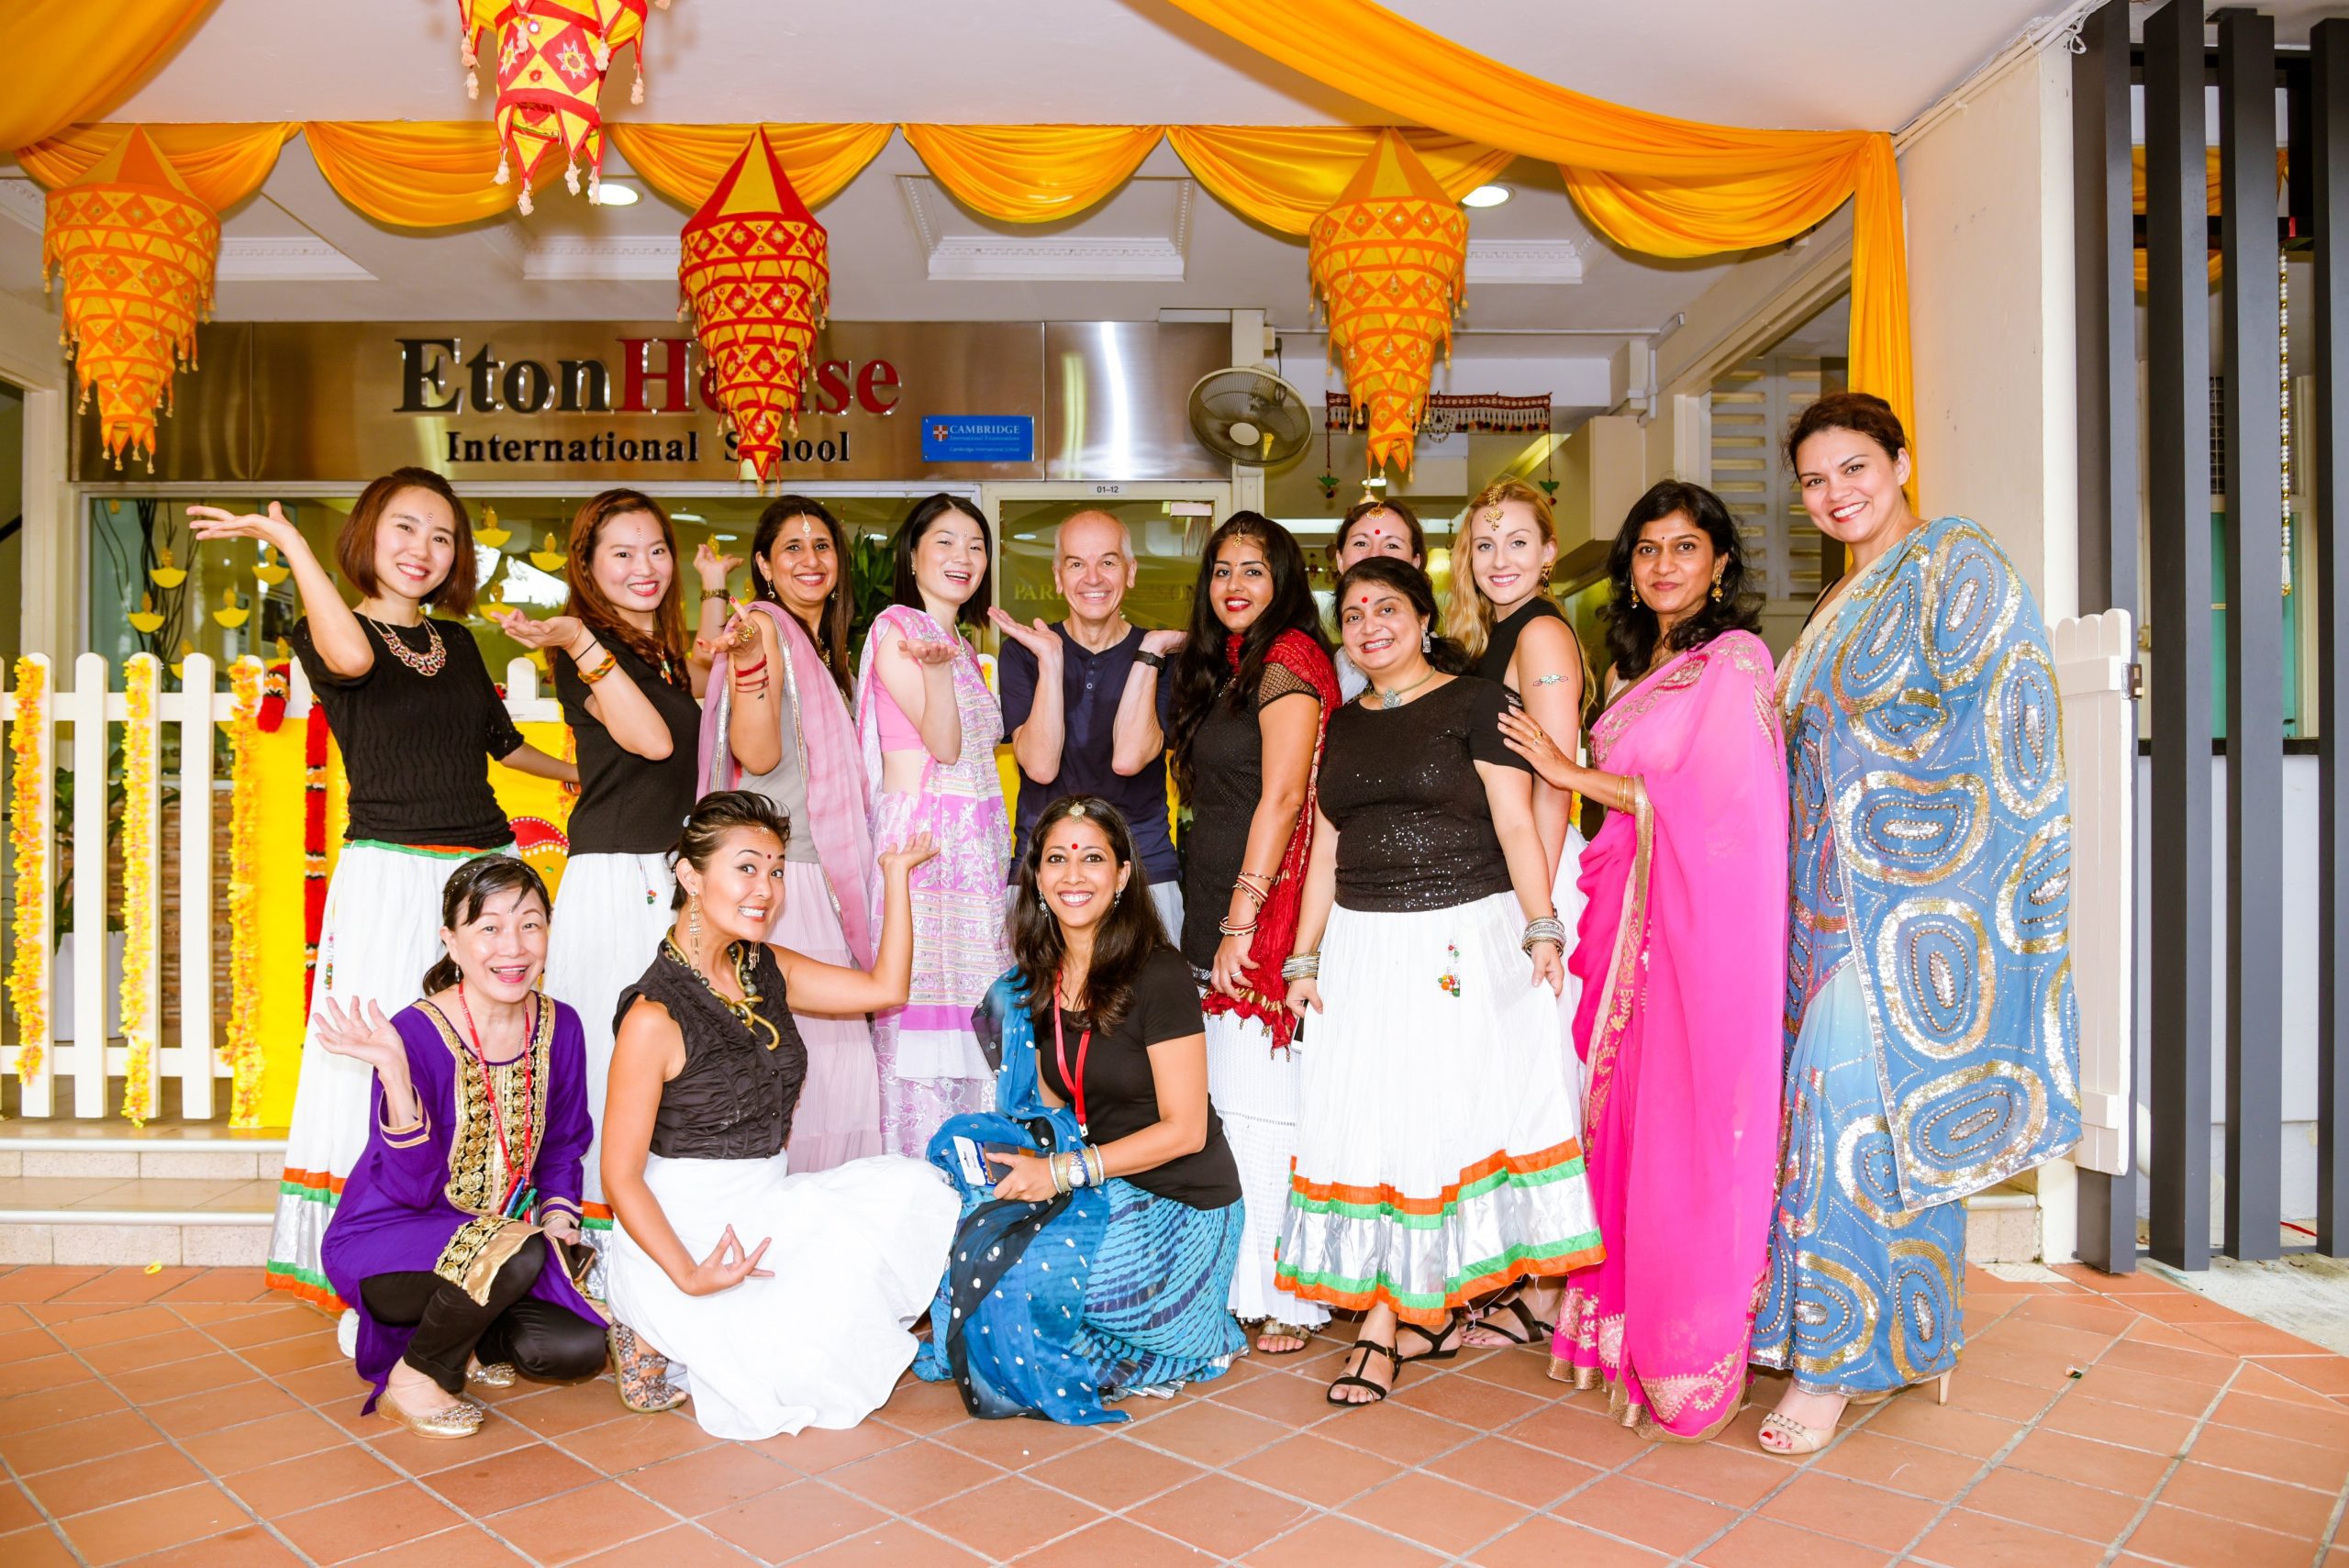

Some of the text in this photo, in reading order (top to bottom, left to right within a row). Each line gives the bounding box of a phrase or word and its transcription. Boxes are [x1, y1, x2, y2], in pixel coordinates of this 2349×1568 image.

[394, 339, 900, 414] EtonHse
[950, 425, 1020, 434] CAMBRIDGE
[446, 431, 850, 462] International Sool
